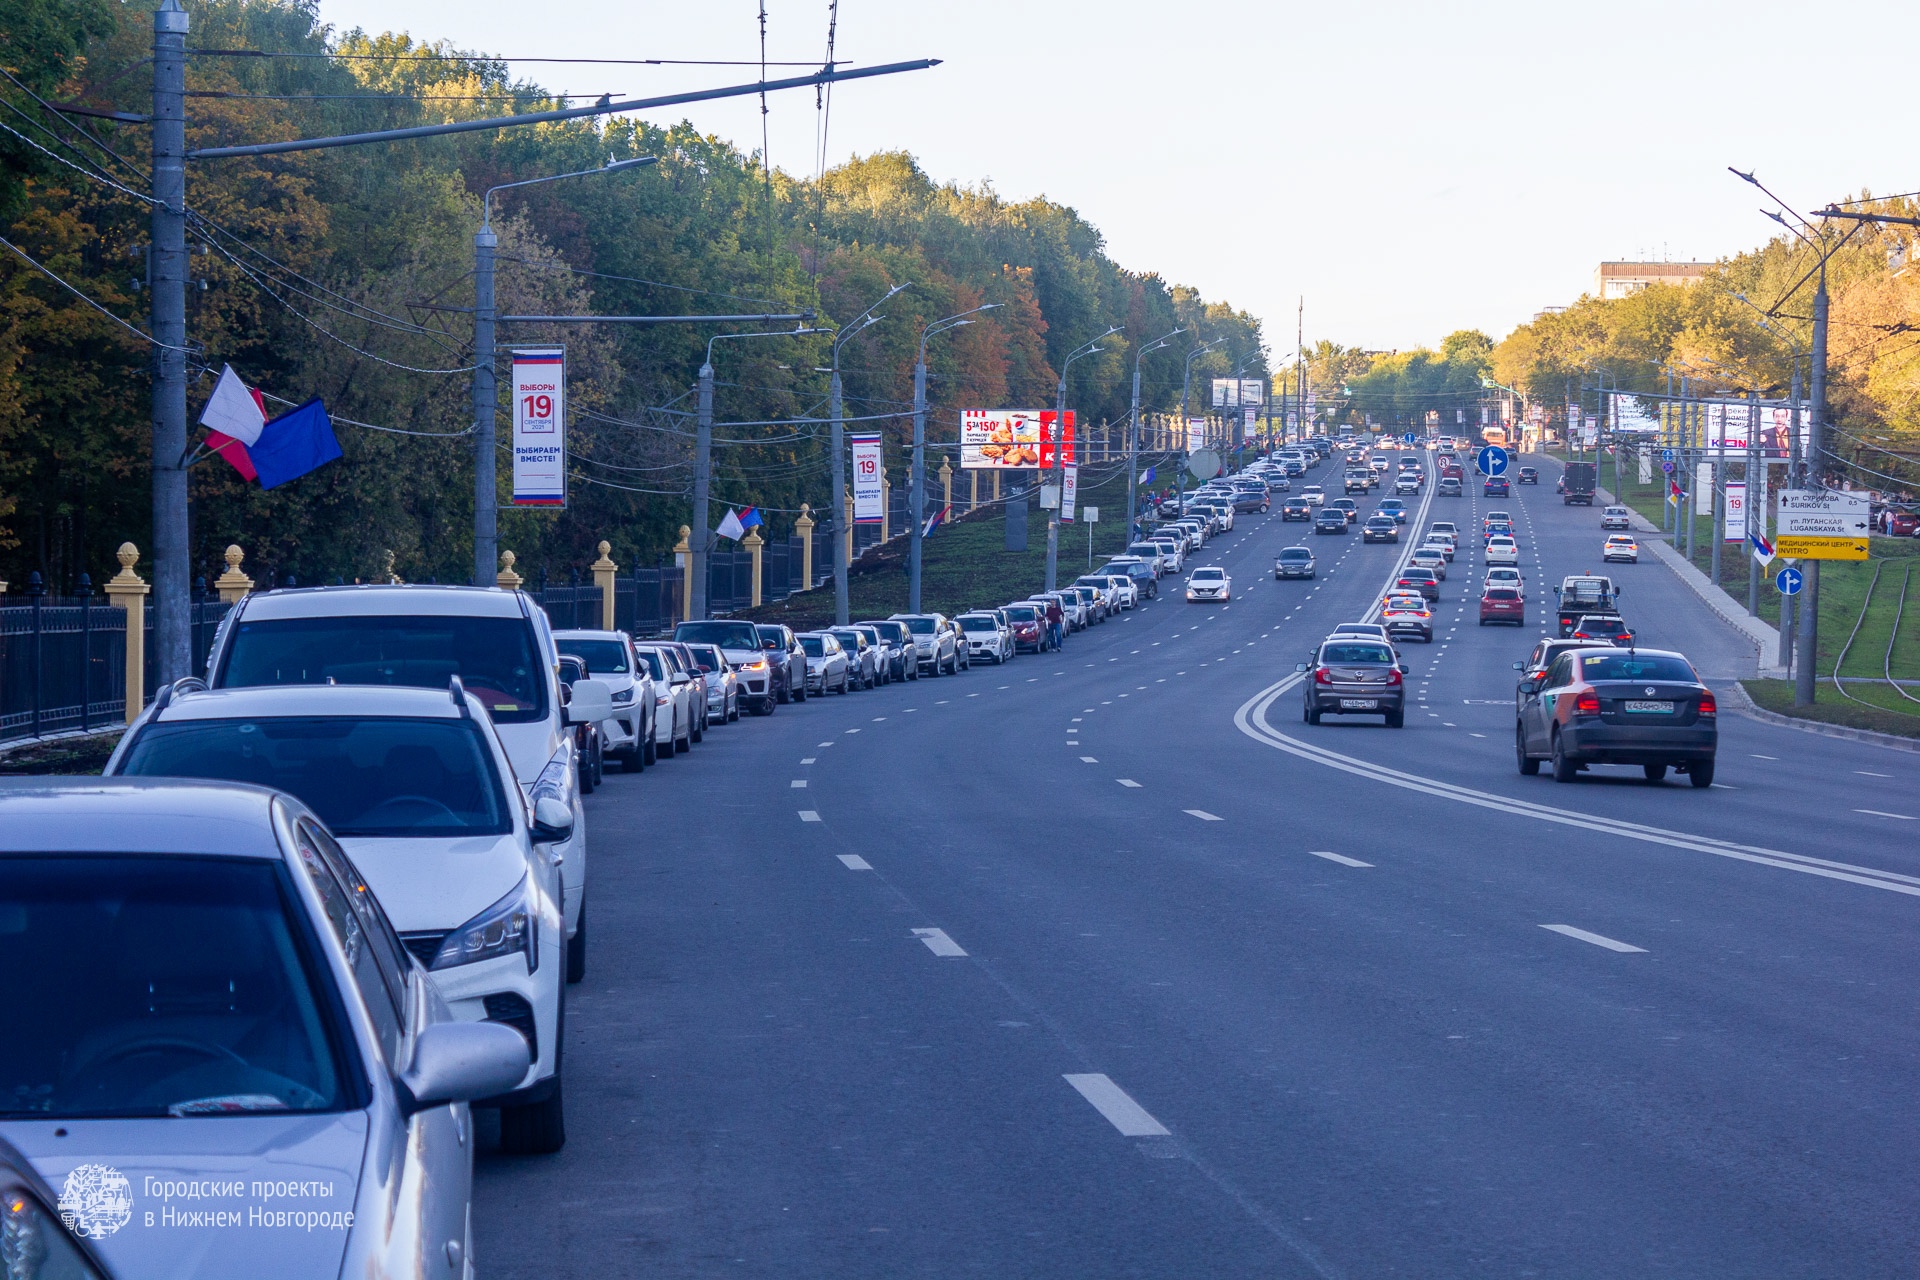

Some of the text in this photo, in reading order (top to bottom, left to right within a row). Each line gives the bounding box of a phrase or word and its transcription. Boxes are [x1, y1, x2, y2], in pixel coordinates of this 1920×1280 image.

[523, 395, 552, 418] 19
[1712, 440, 1747, 448] KON
[520, 455, 556, 463] ВМЕСТЕ!
[1045, 452, 1068, 461] KC
[858, 460, 875, 474] 19
[1730, 500, 1741, 508] 19
